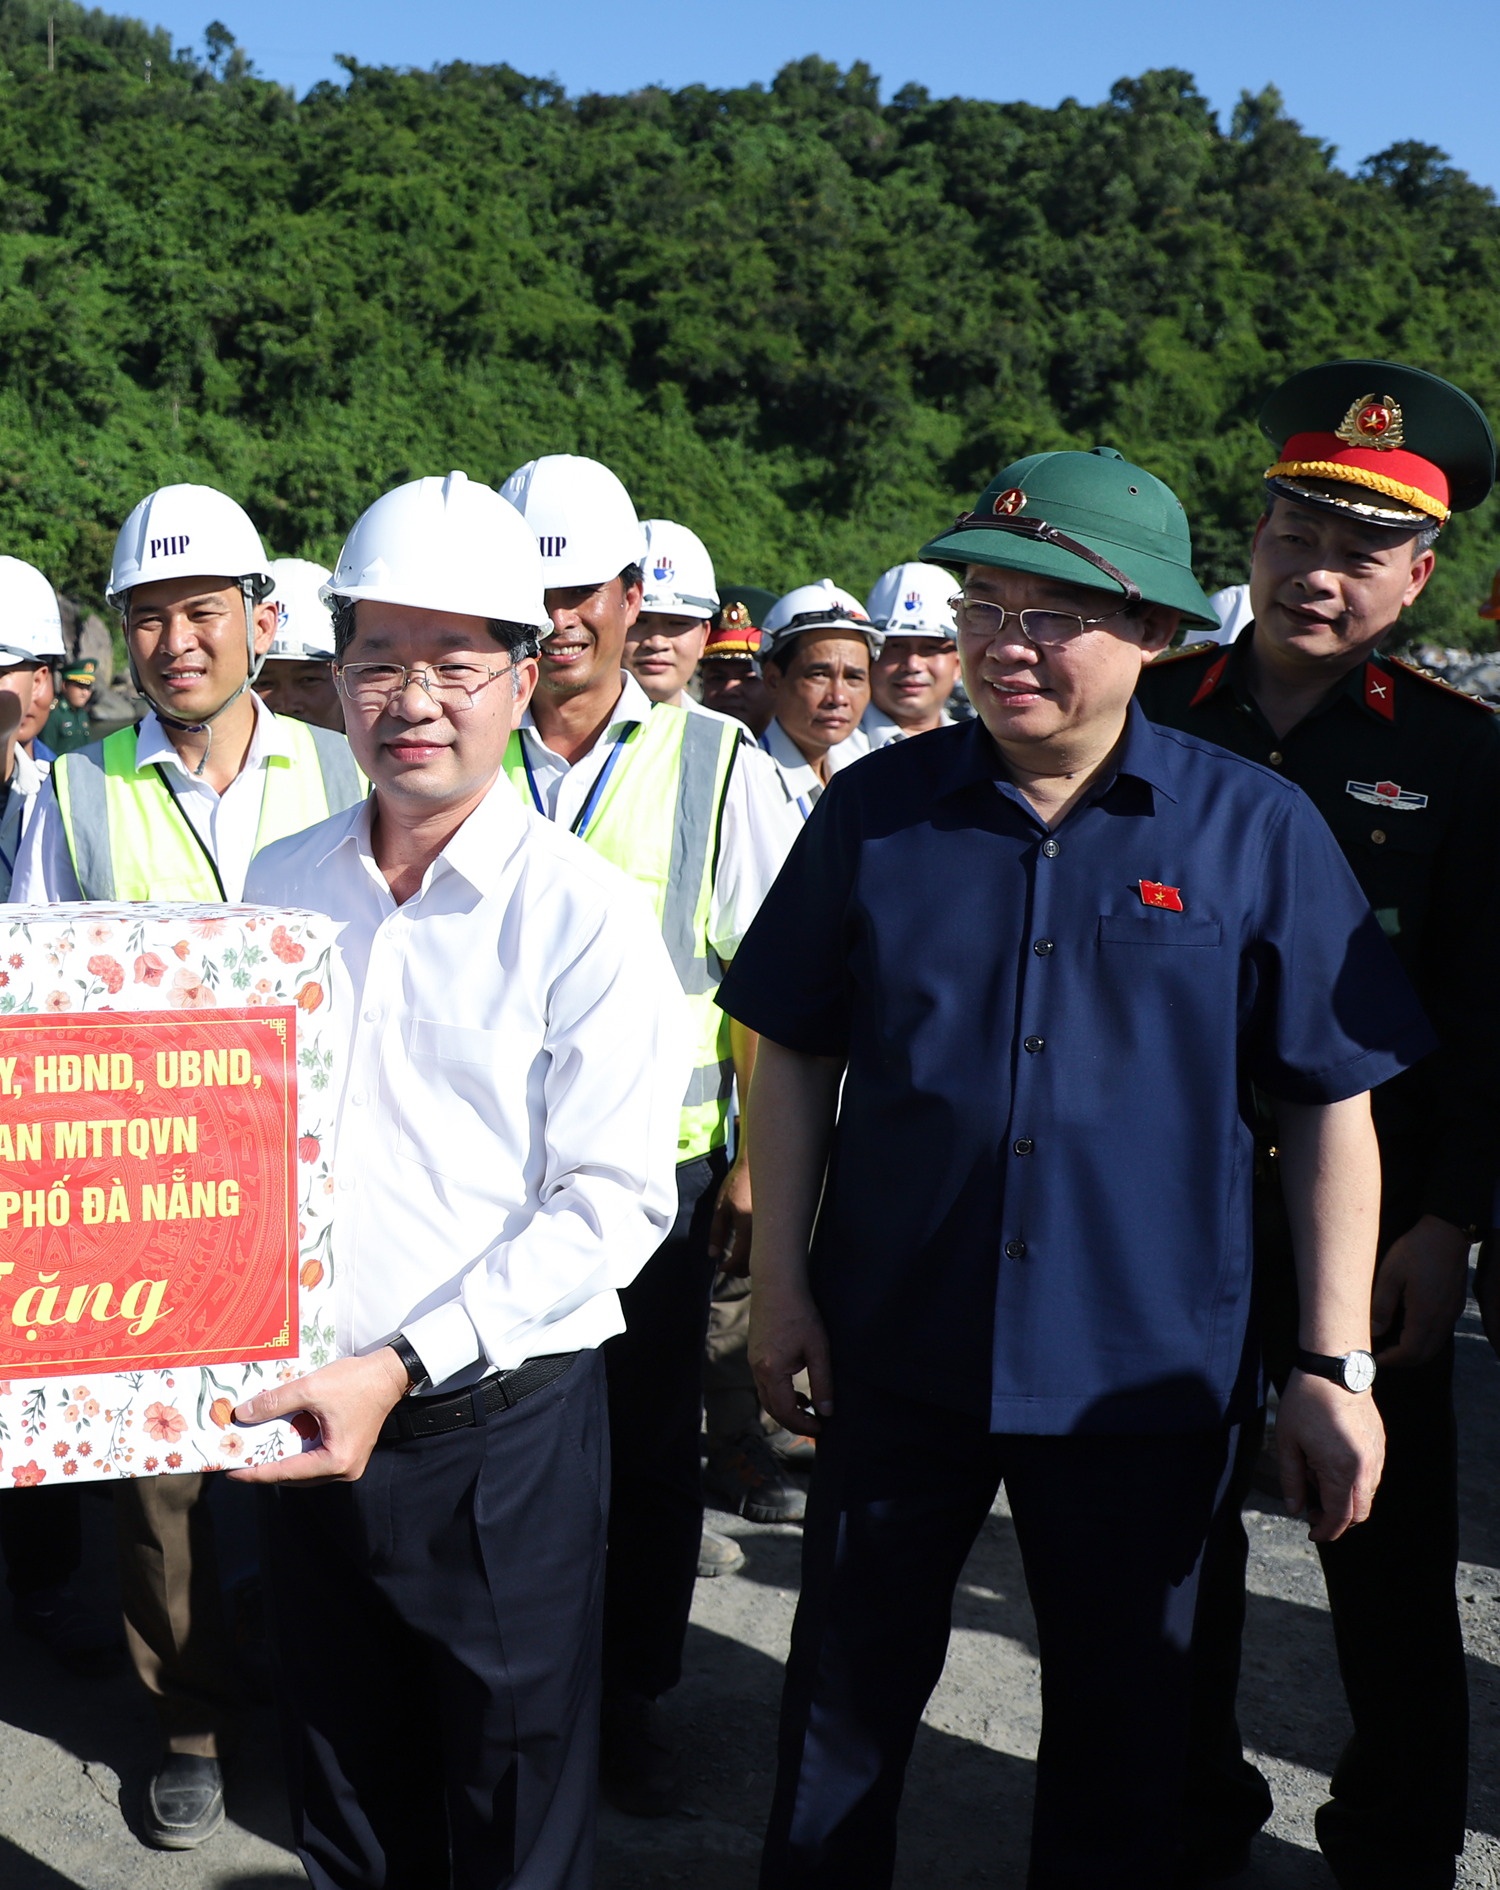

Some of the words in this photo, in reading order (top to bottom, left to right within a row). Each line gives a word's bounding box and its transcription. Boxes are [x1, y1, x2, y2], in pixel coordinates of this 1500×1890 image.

[34, 1052, 145, 1095] HĐND,
[156, 1048, 262, 1090] UBND,
[54, 1115, 198, 1161] MTTQVN
[81, 1177, 131, 1225] ĐÀ
[141, 1167, 240, 1222] NẴNG
